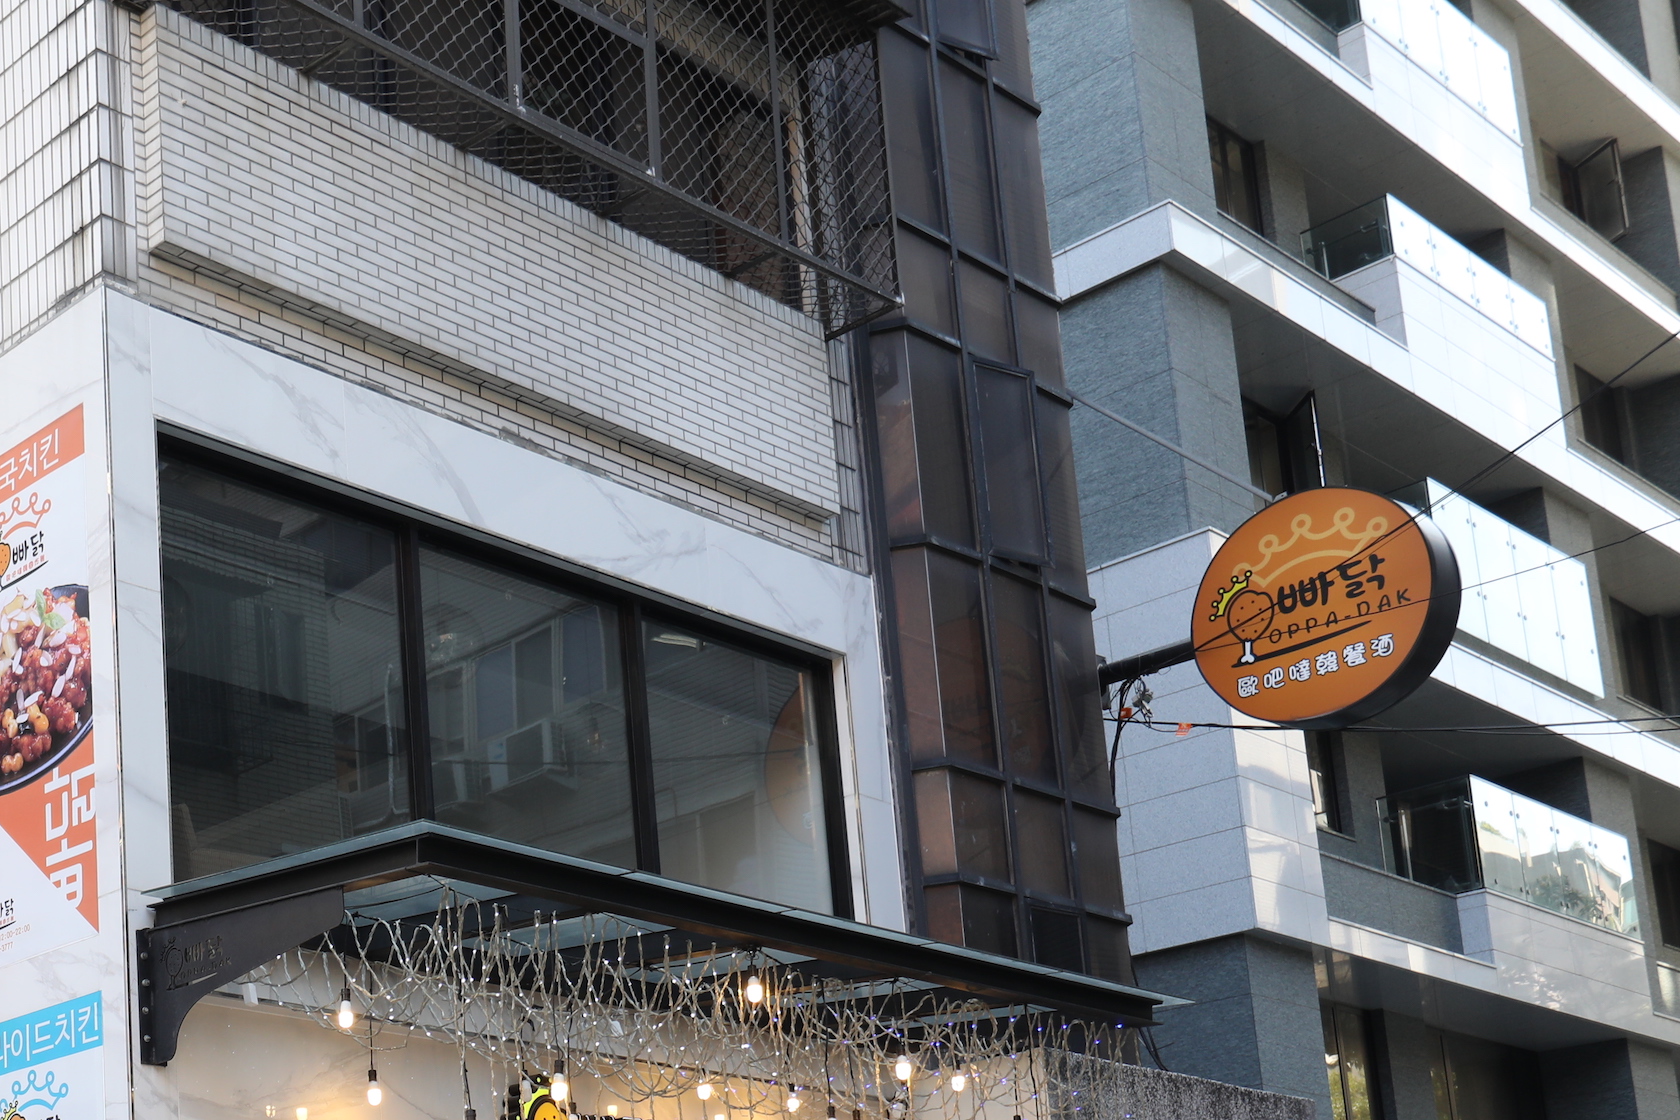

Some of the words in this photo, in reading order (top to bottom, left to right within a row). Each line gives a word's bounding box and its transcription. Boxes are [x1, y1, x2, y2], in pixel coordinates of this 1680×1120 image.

[1277, 554, 1385, 614] 빠닭
[1269, 588, 1411, 644] OPPA-DAK
[1237, 633, 1394, 698] 歐吧噠韓餐酒
